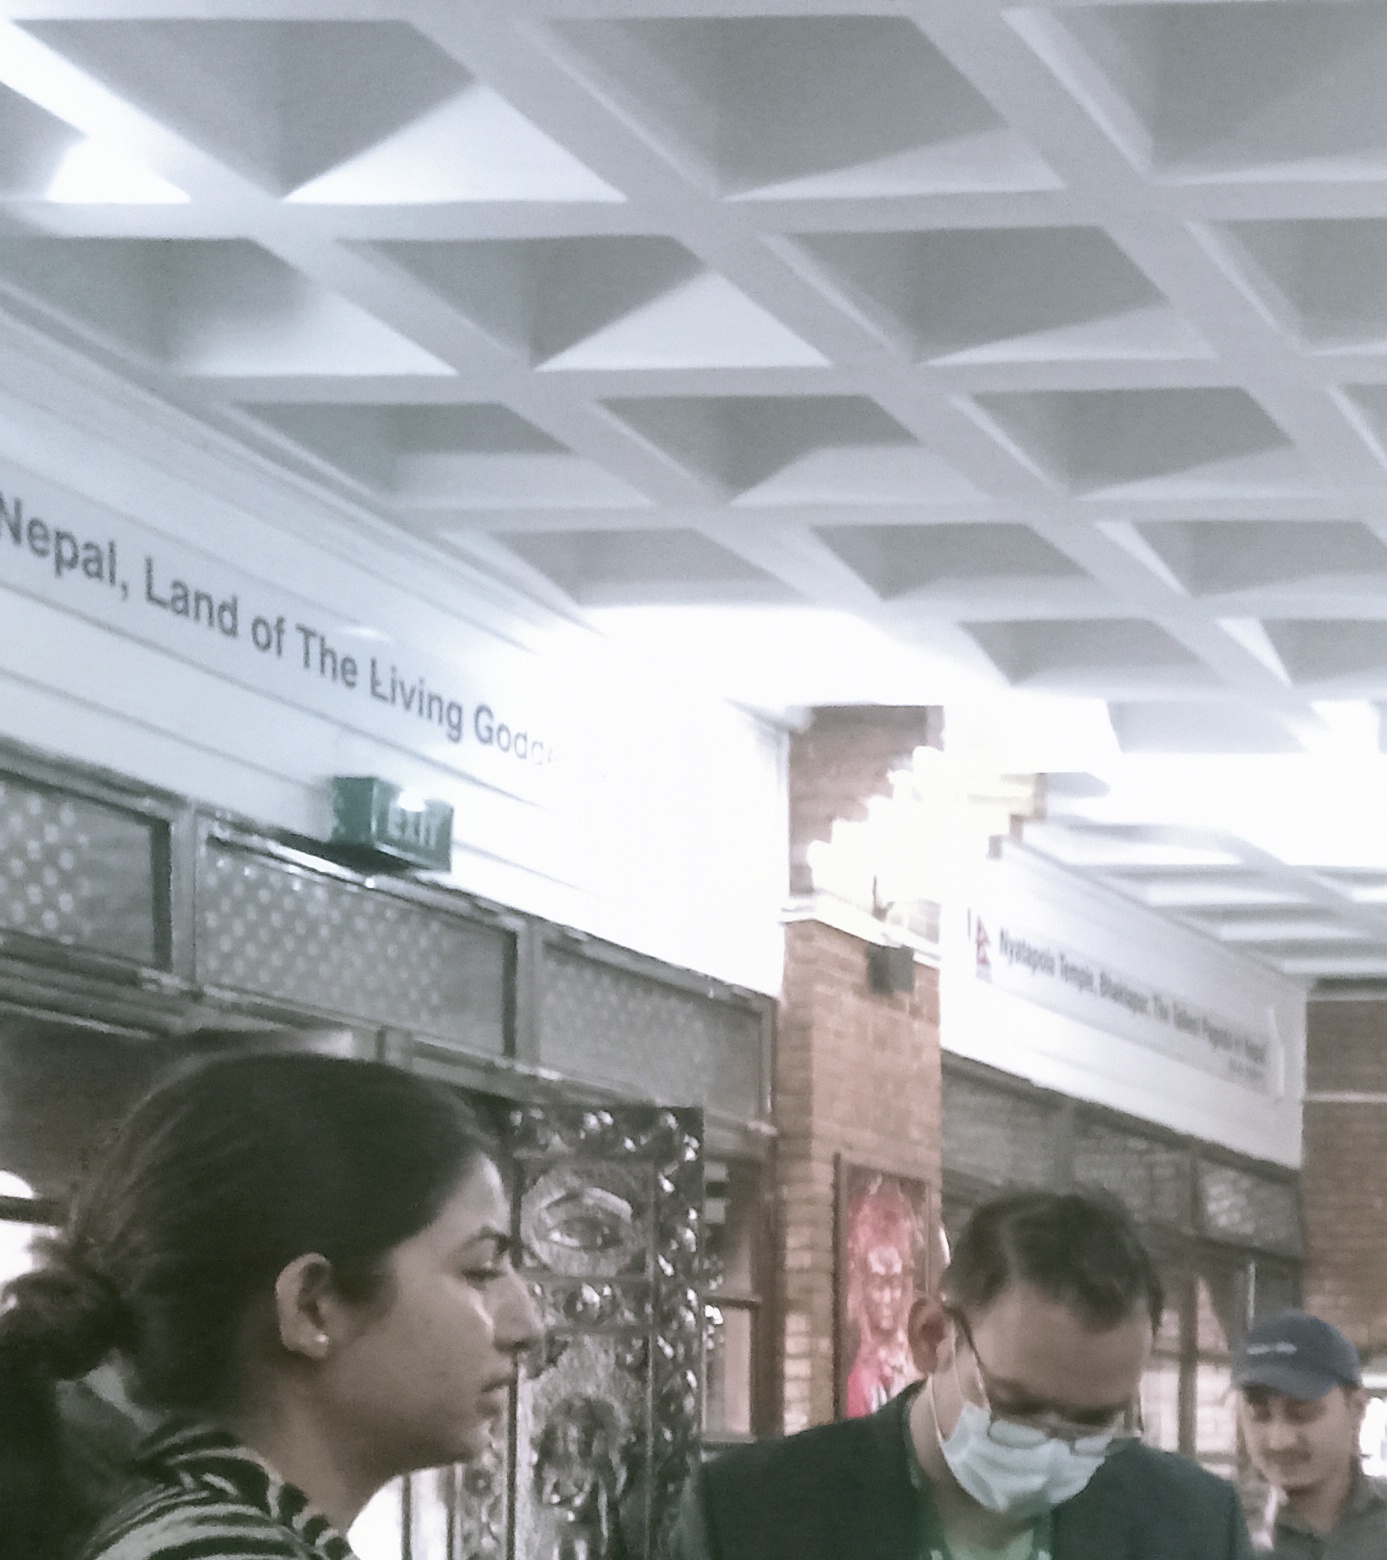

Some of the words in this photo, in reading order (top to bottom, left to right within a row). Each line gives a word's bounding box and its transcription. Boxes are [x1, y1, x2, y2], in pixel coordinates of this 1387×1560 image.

[0, 490, 129, 602] Nepal,
[145, 554, 238, 638] Land
[251, 614, 286, 658] of
[295, 623, 358, 689] The
[370, 656, 463, 743] Living
